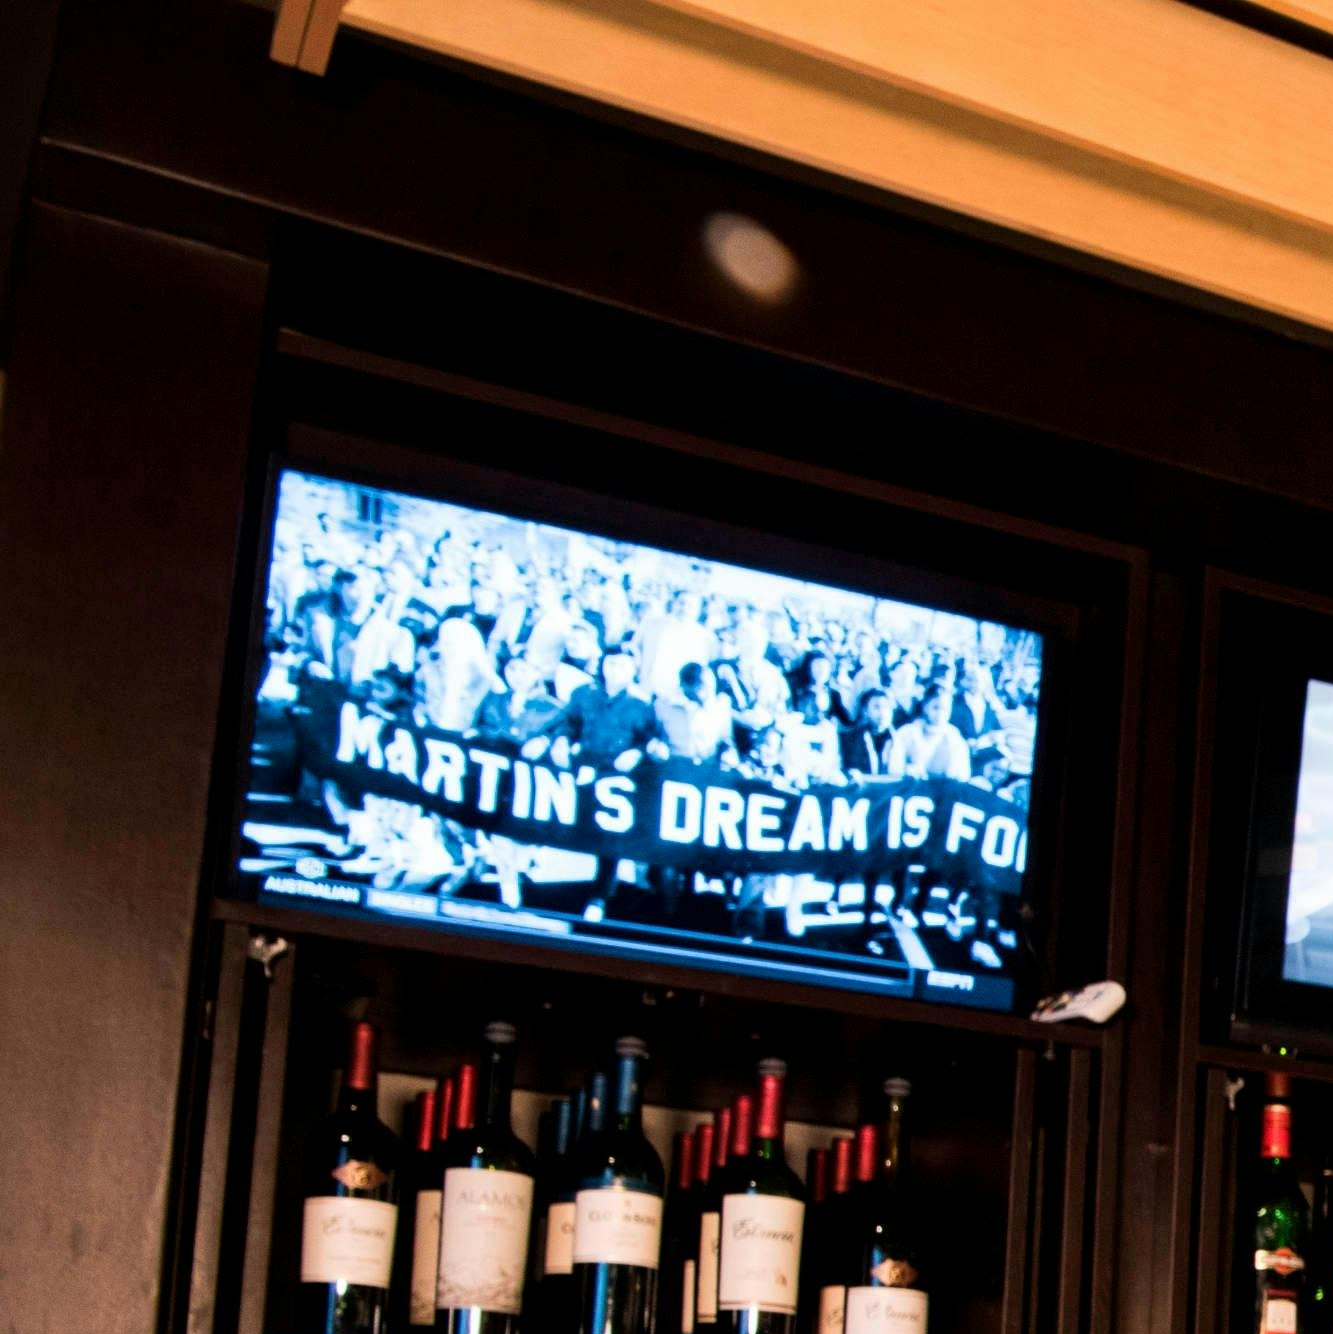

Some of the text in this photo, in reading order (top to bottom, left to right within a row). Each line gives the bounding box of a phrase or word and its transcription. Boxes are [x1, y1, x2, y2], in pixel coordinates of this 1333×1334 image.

[337, 701, 635, 833] MARTIN'S
[659, 778, 869, 852] DREAM
[887, 795, 931, 850] IS
